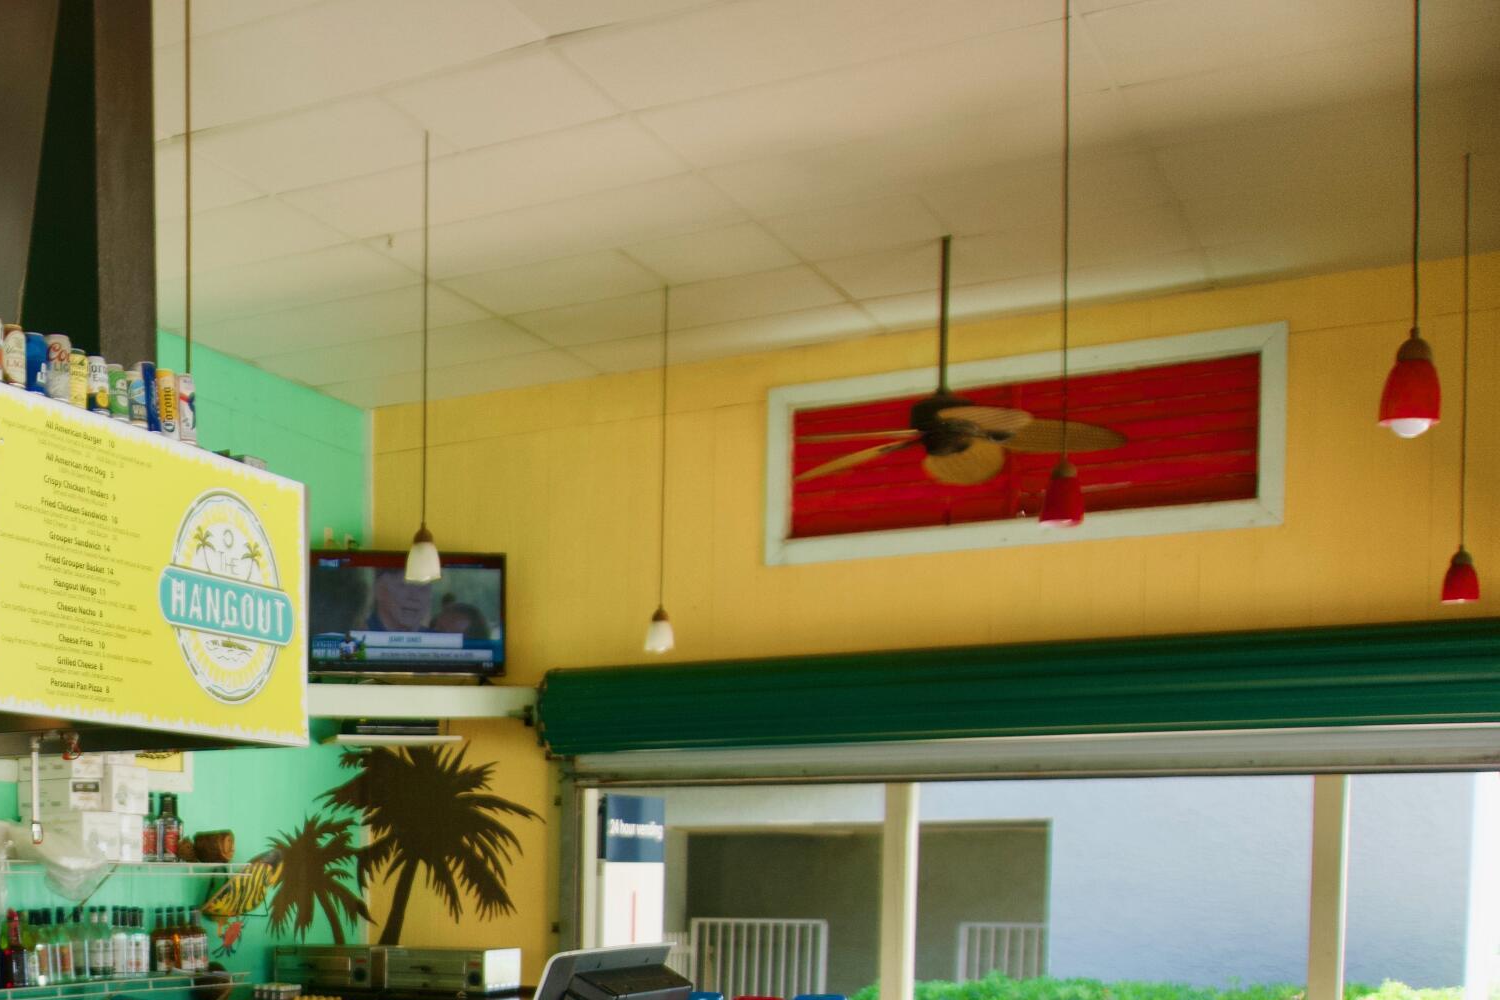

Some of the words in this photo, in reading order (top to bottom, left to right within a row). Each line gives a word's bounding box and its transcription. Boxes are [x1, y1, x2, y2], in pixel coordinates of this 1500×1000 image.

[54, 423, 82, 439] American
[83, 430, 102, 445] Burger
[54, 456, 82, 471] American
[94, 466, 106, 479] Dog
[44, 475, 62, 489] Crispy
[63, 480, 85, 494] Chicken
[86, 487, 109, 500] Tenders
[41, 497, 56, 509] Fried
[57, 501, 80, 515] Chicken
[81, 507, 108, 522] Sandwich
[49, 531, 73, 545] Grouper
[74, 537, 101, 550] Sandwich
[45, 553, 60, 565] Fried
[61, 557, 85, 571] Grouper
[86, 563, 105, 574] Basket
[53, 579, 78, 592] Hangout
[79, 584, 97, 596] Wings
[57, 602, 77, 614] Cheese
[78, 606, 96, 617] Nacho
[171, 576, 286, 637] HANGOUT
[58, 634, 79, 646] Cheese
[80, 637, 93, 647] Fries
[57, 656, 76, 667] Grilled
[77, 659, 97, 670] Cheese
[50, 678, 75, 690] Personal
[76, 681, 87, 691] Pan
[88, 683, 103, 693] Pizza
[608, 819, 620, 837] 24
[620, 819, 636, 838] hour
[636, 821, 664, 844] vending
